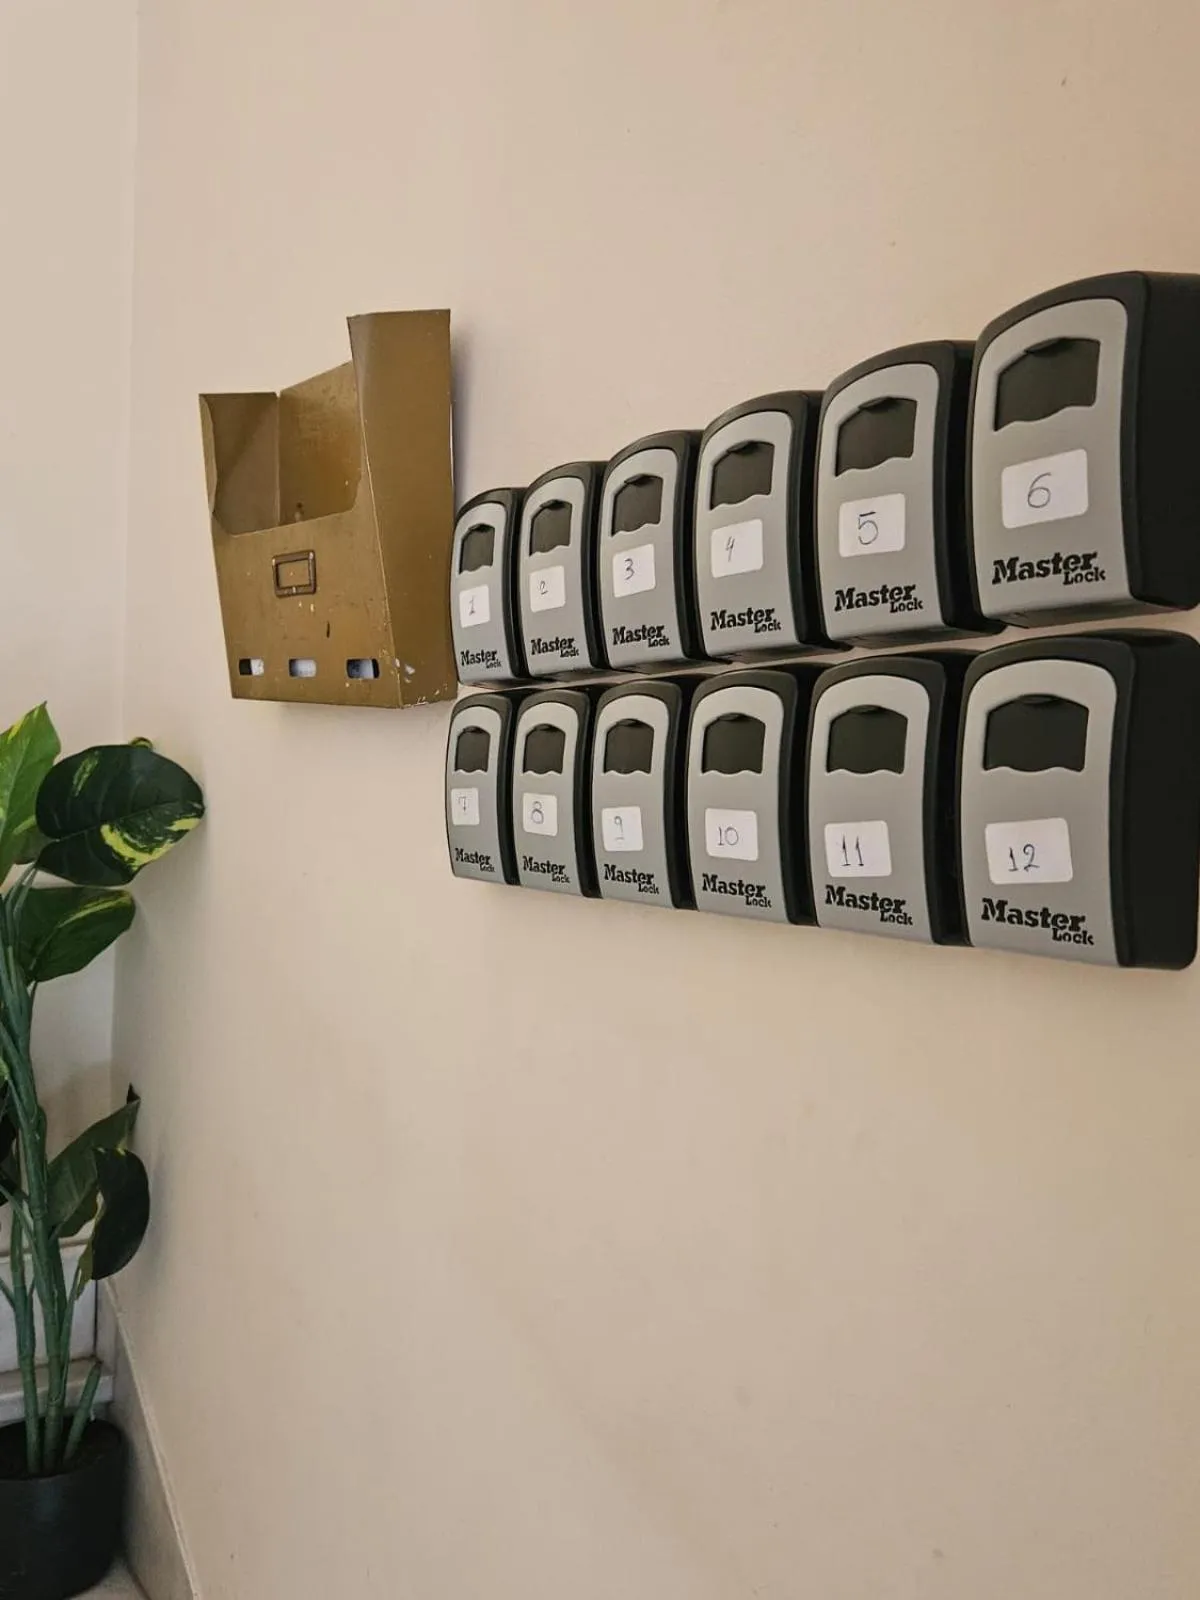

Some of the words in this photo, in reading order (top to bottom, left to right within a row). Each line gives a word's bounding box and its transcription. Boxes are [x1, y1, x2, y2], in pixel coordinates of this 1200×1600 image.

[1027, 472, 1052, 509] 6
[857, 511, 879, 545] 5
[725, 536, 736, 562] 4
[623, 558, 635, 580] 3
[992, 551, 1098, 585] Master
[1062, 567, 1106, 586] Lock
[539, 580, 549, 595] 2
[834, 584, 917, 612] Master
[468, 595, 476, 616] 1
[890, 597, 924, 614] Lock
[710, 607, 776, 631] Master
[754, 619, 782, 633] Lock
[612, 624, 665, 646] Master
[648, 636, 670, 648] Lock
[531, 637, 575, 655] Master
[559, 647, 580, 658] Lock
[460, 649, 498, 666] Master
[531, 801, 545, 825] 8
[613, 815, 625, 840] 9
[717, 826, 739, 846] 10
[455, 847, 491, 865] Master
[841, 834, 864, 866] 11
[1008, 843, 1039, 872] 12
[522, 855, 566, 875] Master
[604, 864, 655, 885] Master
[551, 871, 571, 884] Lock
[702, 873, 766, 898] Master
[638, 882, 660, 895] Lock
[745, 895, 772, 908] Lock
[825, 885, 906, 914] Master
[879, 910, 914, 926] Lock
[981, 897, 1086, 932] Master
[1052, 927, 1095, 946] Lock
